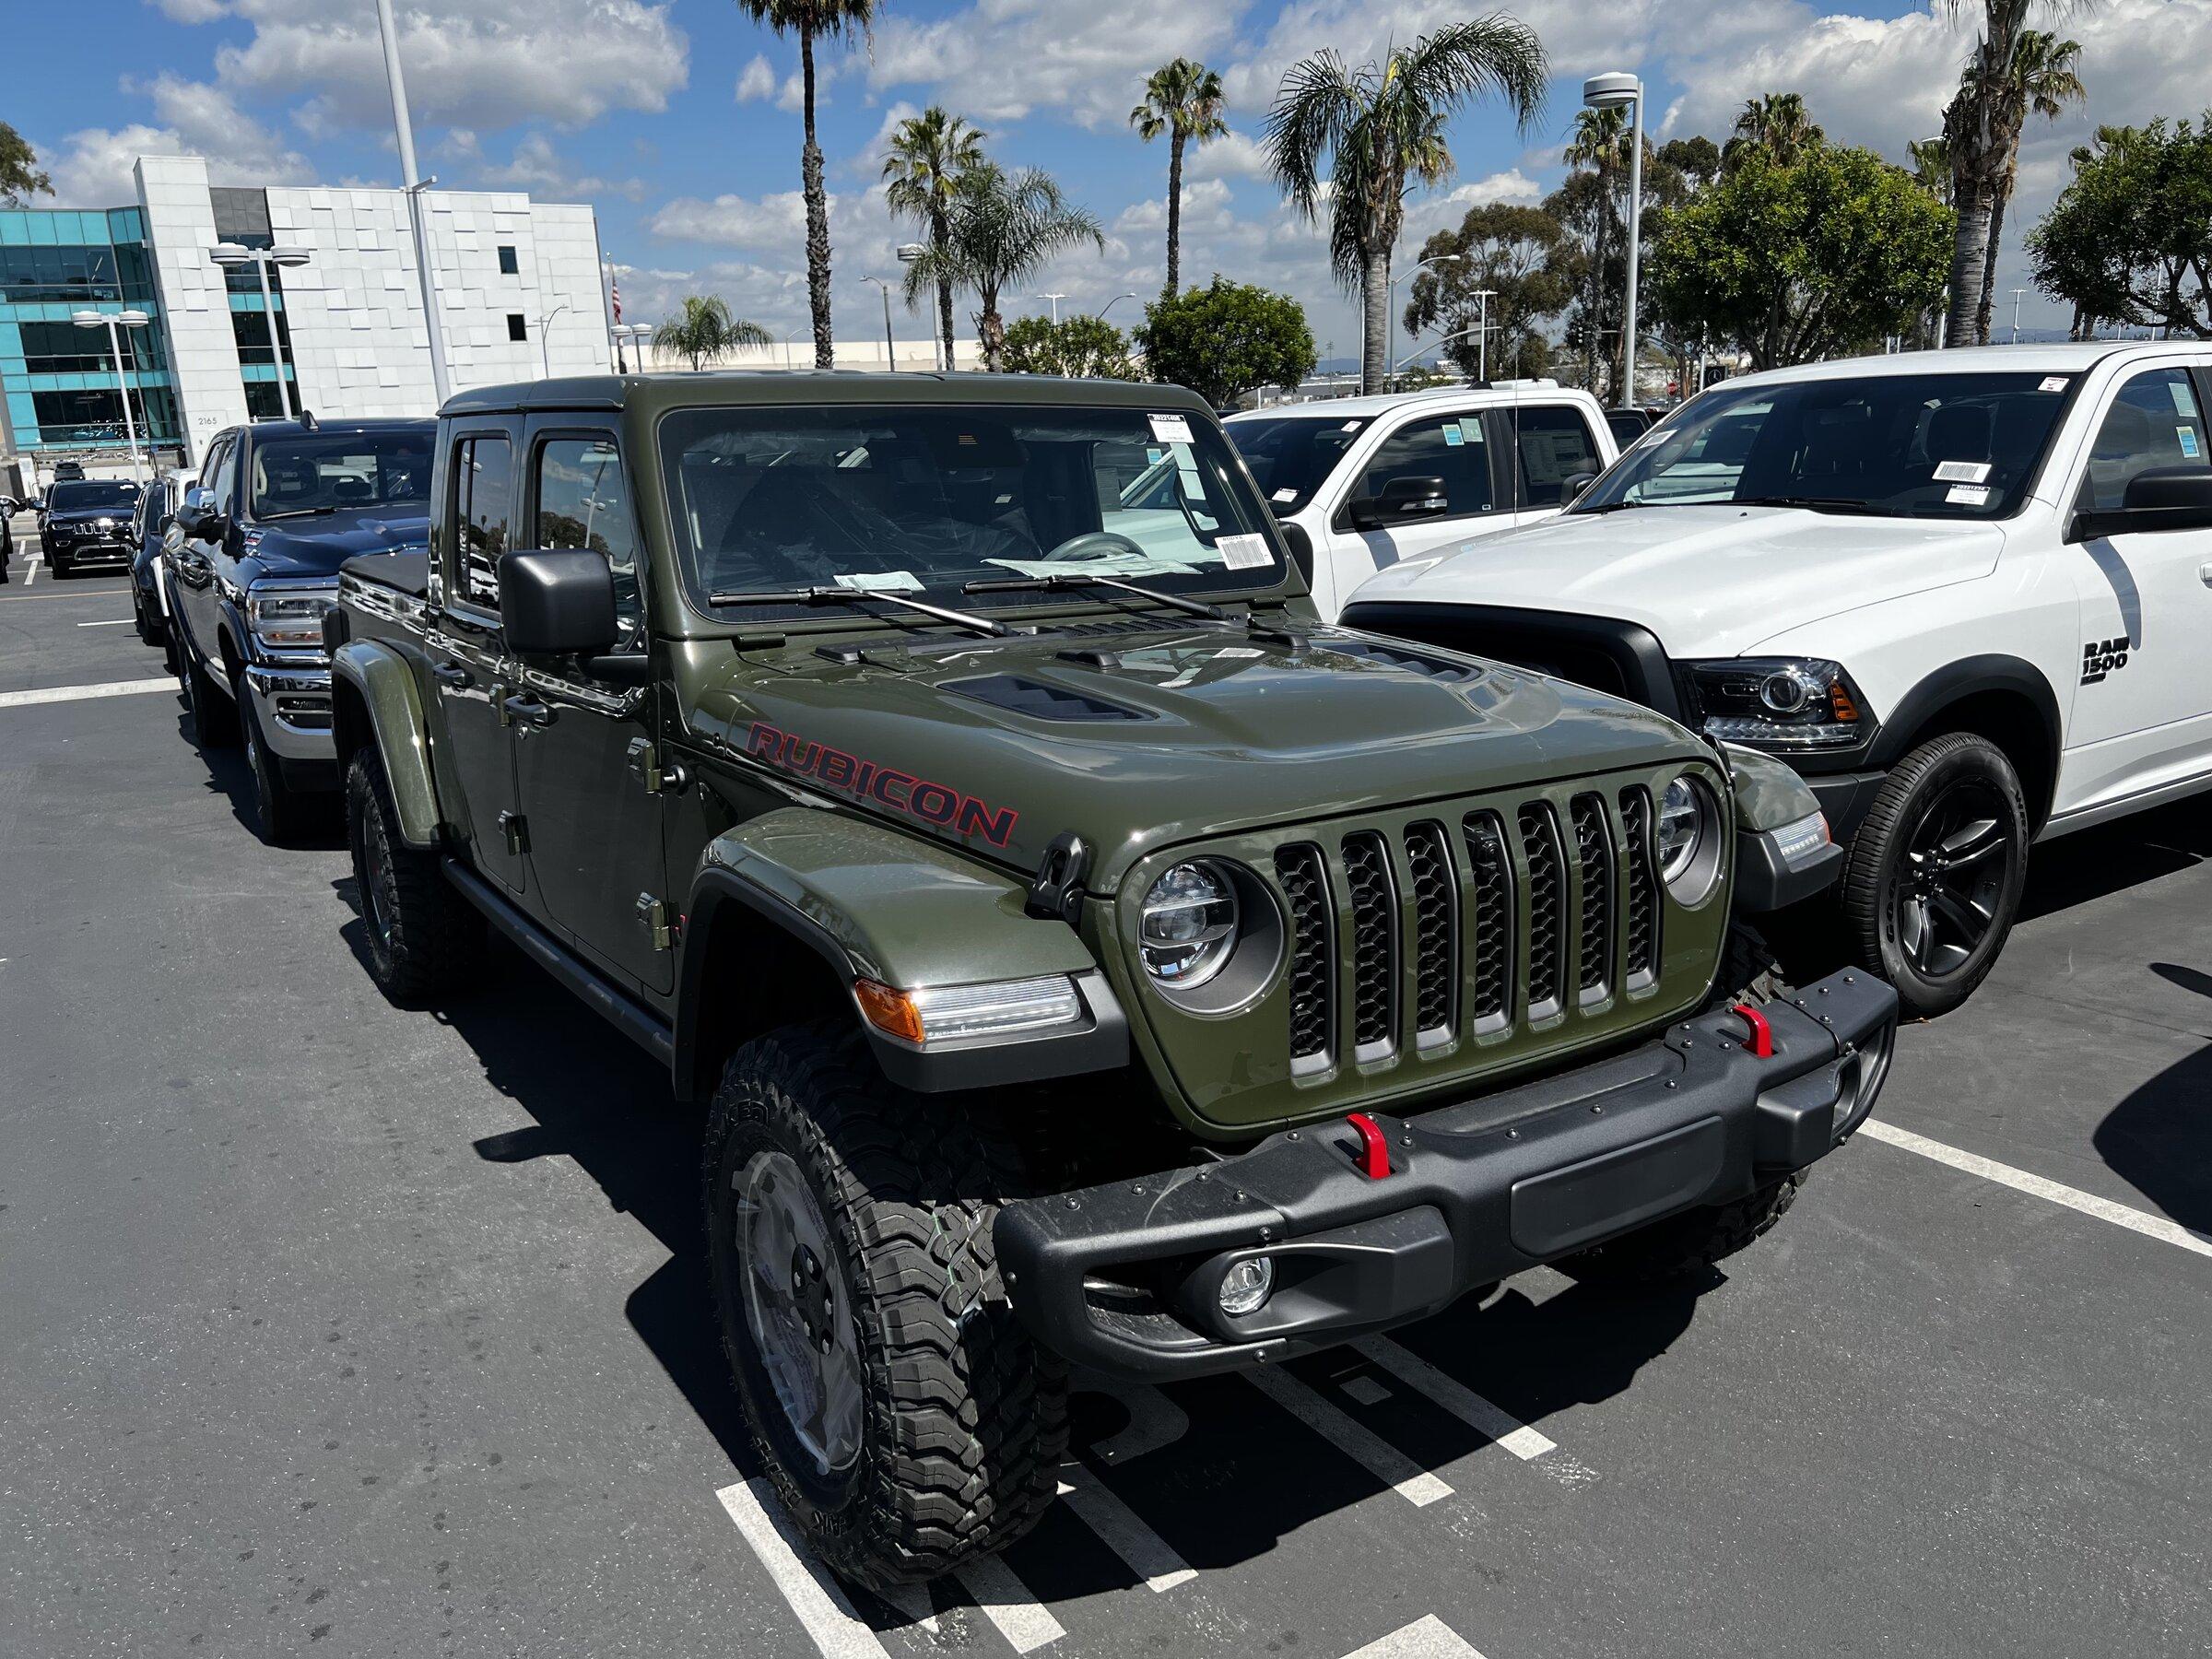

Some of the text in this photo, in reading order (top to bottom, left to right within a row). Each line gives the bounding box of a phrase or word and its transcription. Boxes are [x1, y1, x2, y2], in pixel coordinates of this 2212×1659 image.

[198, 417, 218, 425] 2165
[2083, 636, 2130, 659] RAM
[2082, 653, 2128, 676] 1500
[746, 722, 1018, 848] RUBICON
